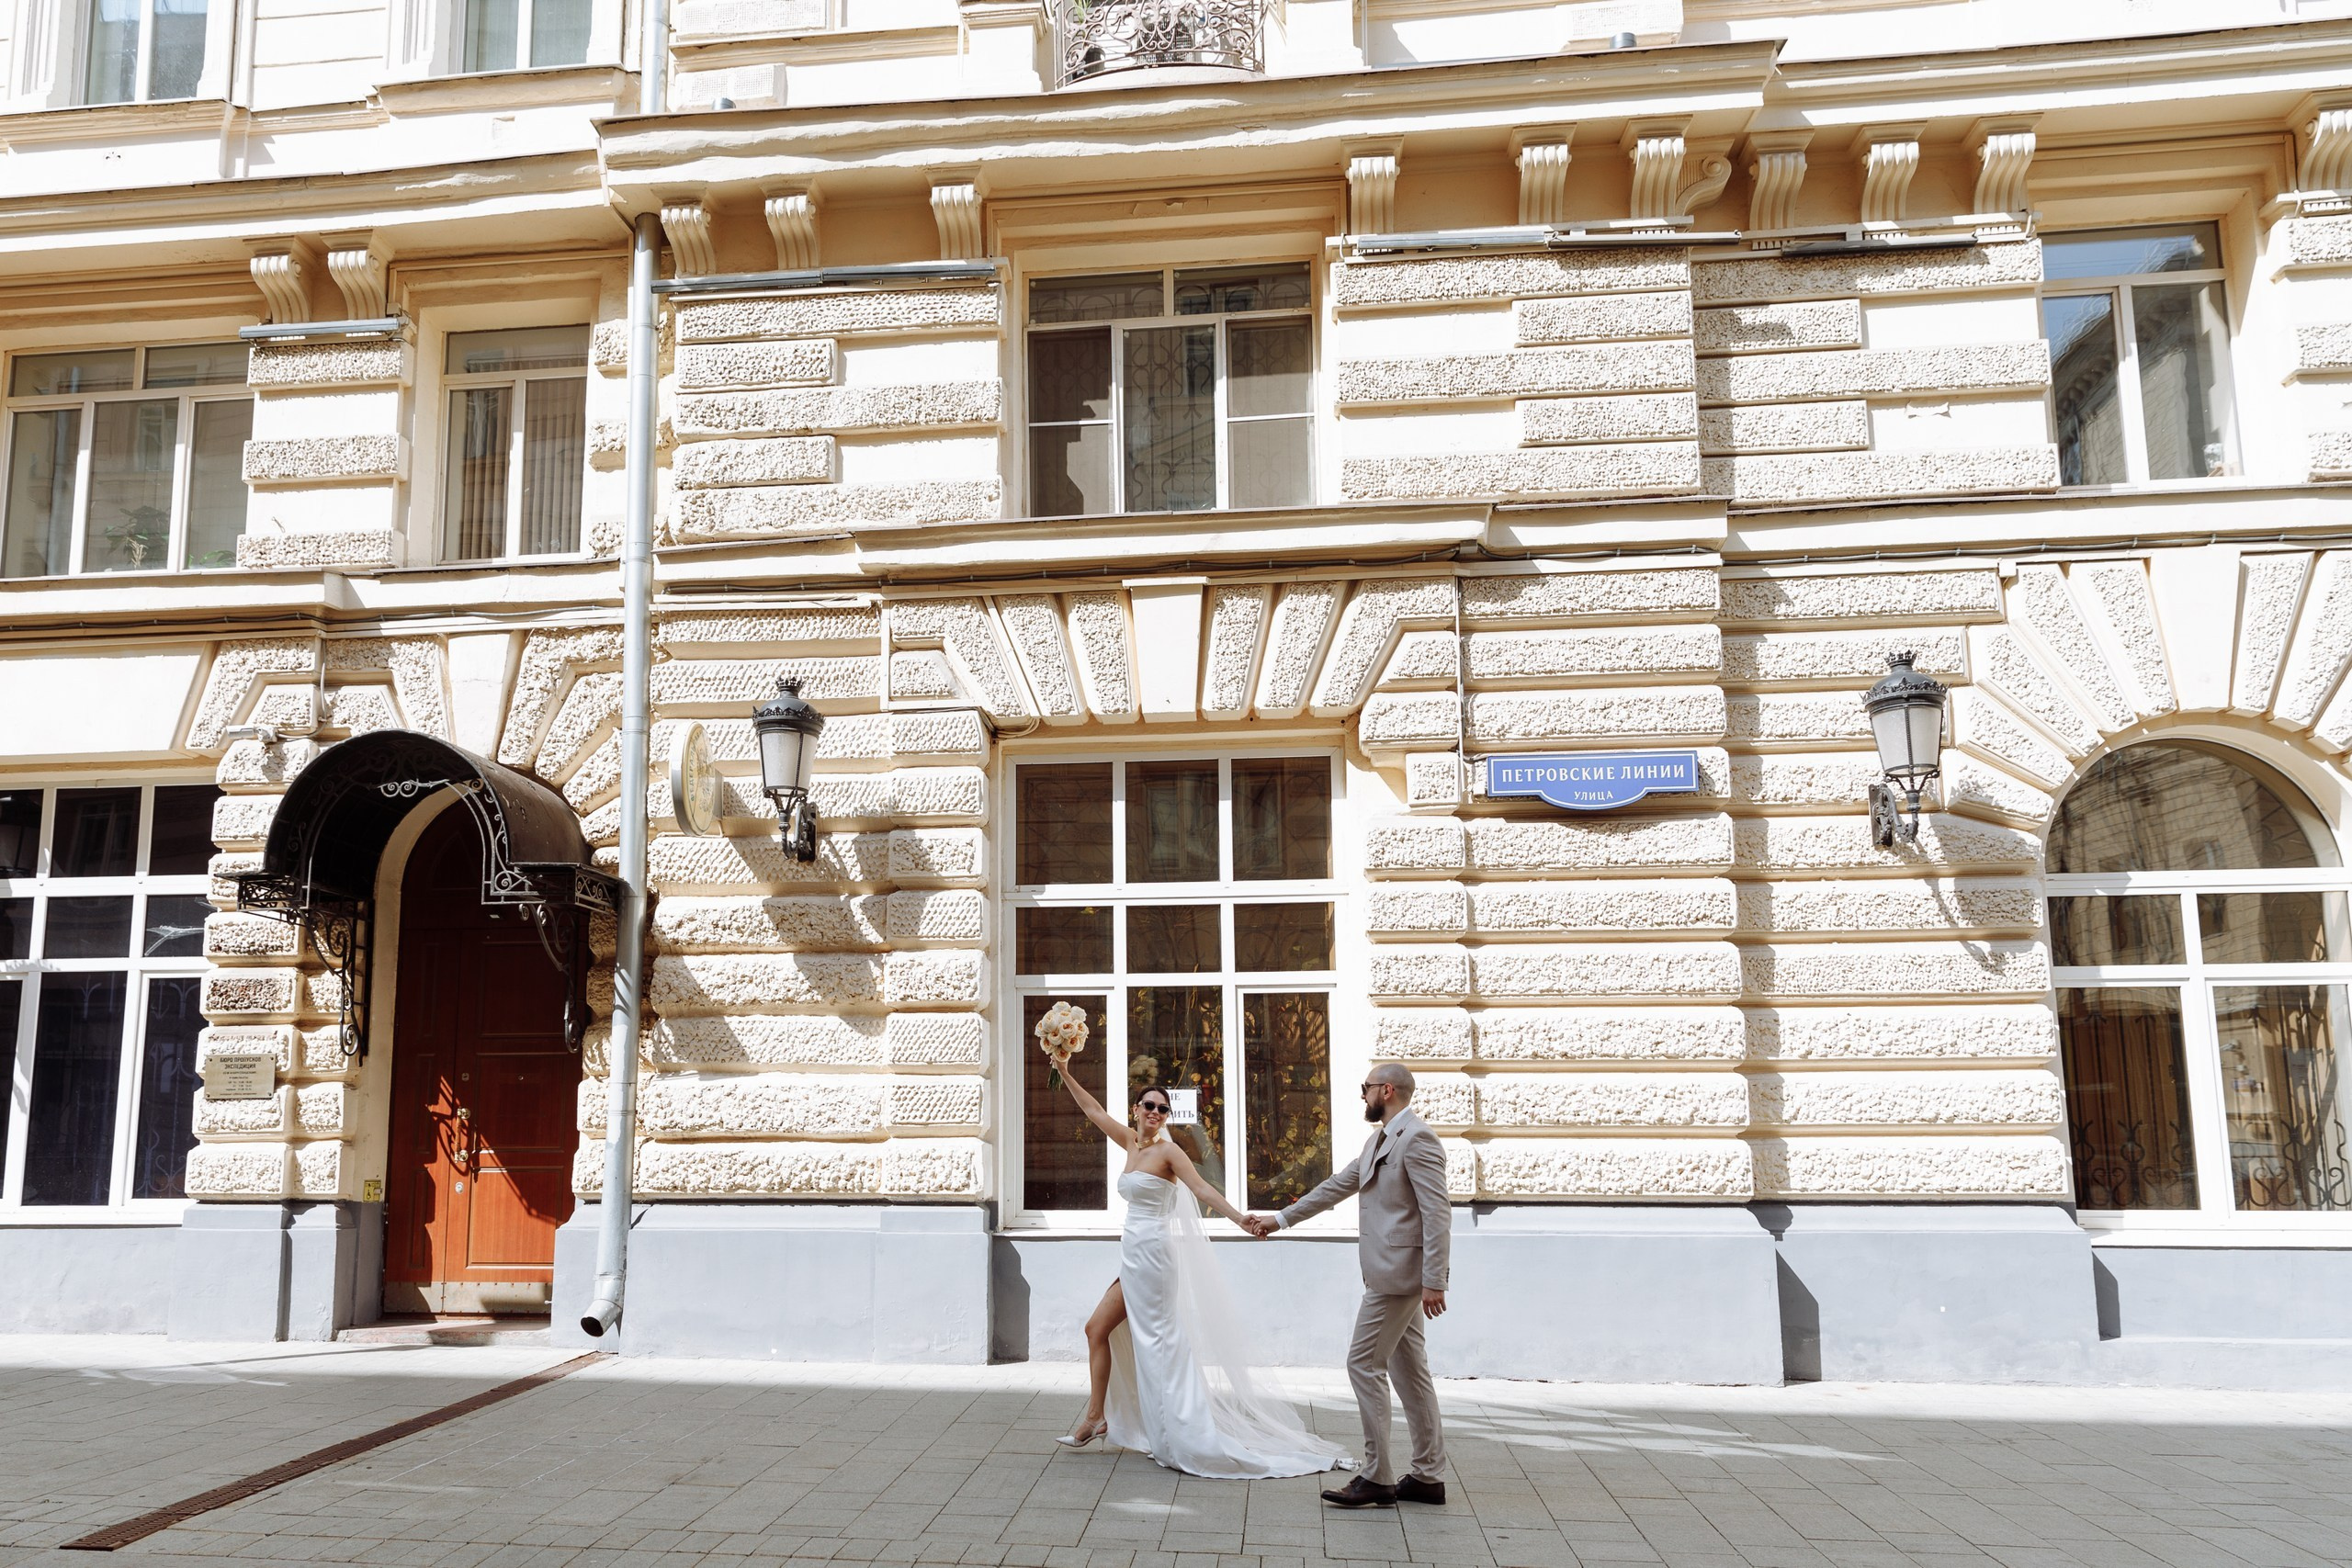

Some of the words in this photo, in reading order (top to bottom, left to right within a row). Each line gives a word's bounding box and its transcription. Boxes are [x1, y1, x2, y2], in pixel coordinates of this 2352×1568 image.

[1502, 766, 1615, 783] ПЕТРОВСКИЕ
[1621, 764, 1685, 780] ЛИНИИ
[1574, 790, 1614, 801] УЛИЦА
